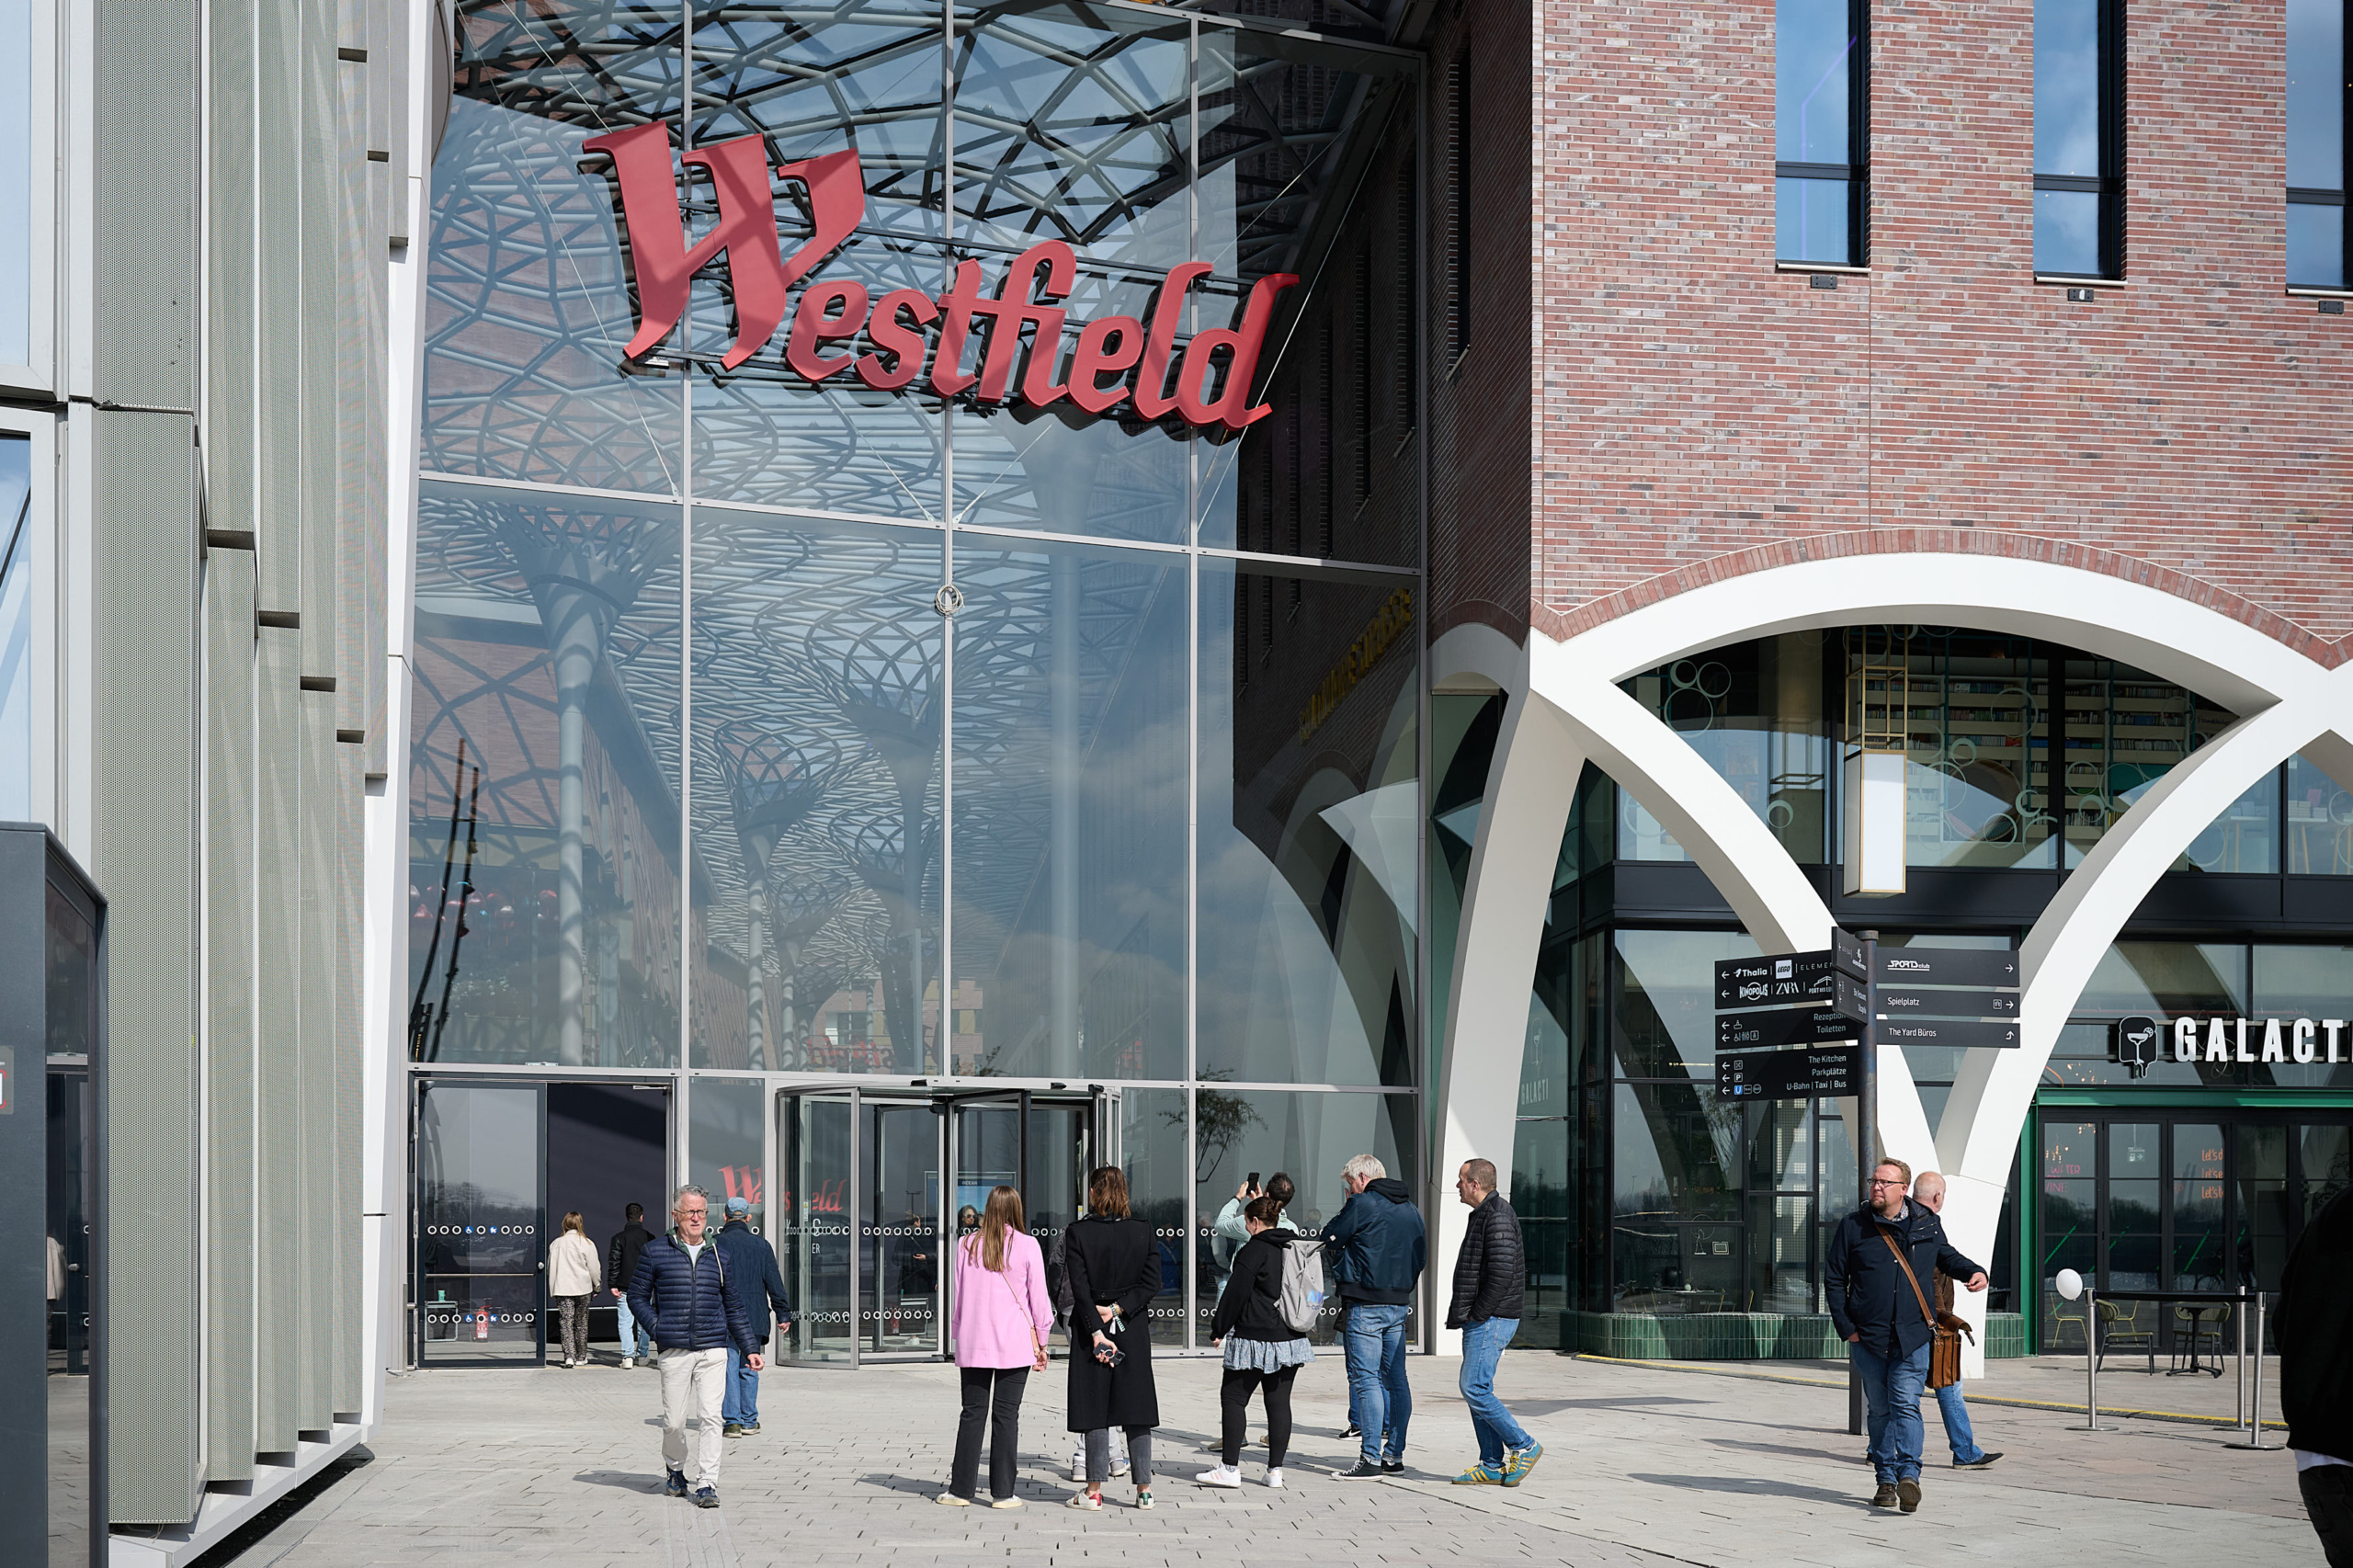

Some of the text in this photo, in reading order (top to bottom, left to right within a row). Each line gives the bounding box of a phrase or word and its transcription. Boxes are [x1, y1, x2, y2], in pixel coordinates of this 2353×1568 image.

[582, 119, 1299, 431] Westfield
[1742, 968, 1768, 977] Thalia
[1778, 965, 1790, 973] LEGO
[1739, 983, 1768, 999] KINOPOLIS
[1776, 982, 1800, 995] ZARA
[1887, 996, 1920, 1006] Spielplatz
[1813, 1012, 1847, 1021] Rezeption
[1816, 1025, 1847, 1034] Toiletten
[1889, 1028, 1937, 1037] The Yard Büros
[2175, 1016, 2353, 1063] GALACT
[1808, 1054, 1847, 1064] The Kitchen
[1812, 1067, 1847, 1077] Parkplätze
[1787, 1080, 1847, 1091] U-Bahn Taxi Bus
[2201, 1149, 2217, 1162] Let's
[718, 1165, 847, 1212] Weseld
[2201, 1186, 2217, 1199] Let's
